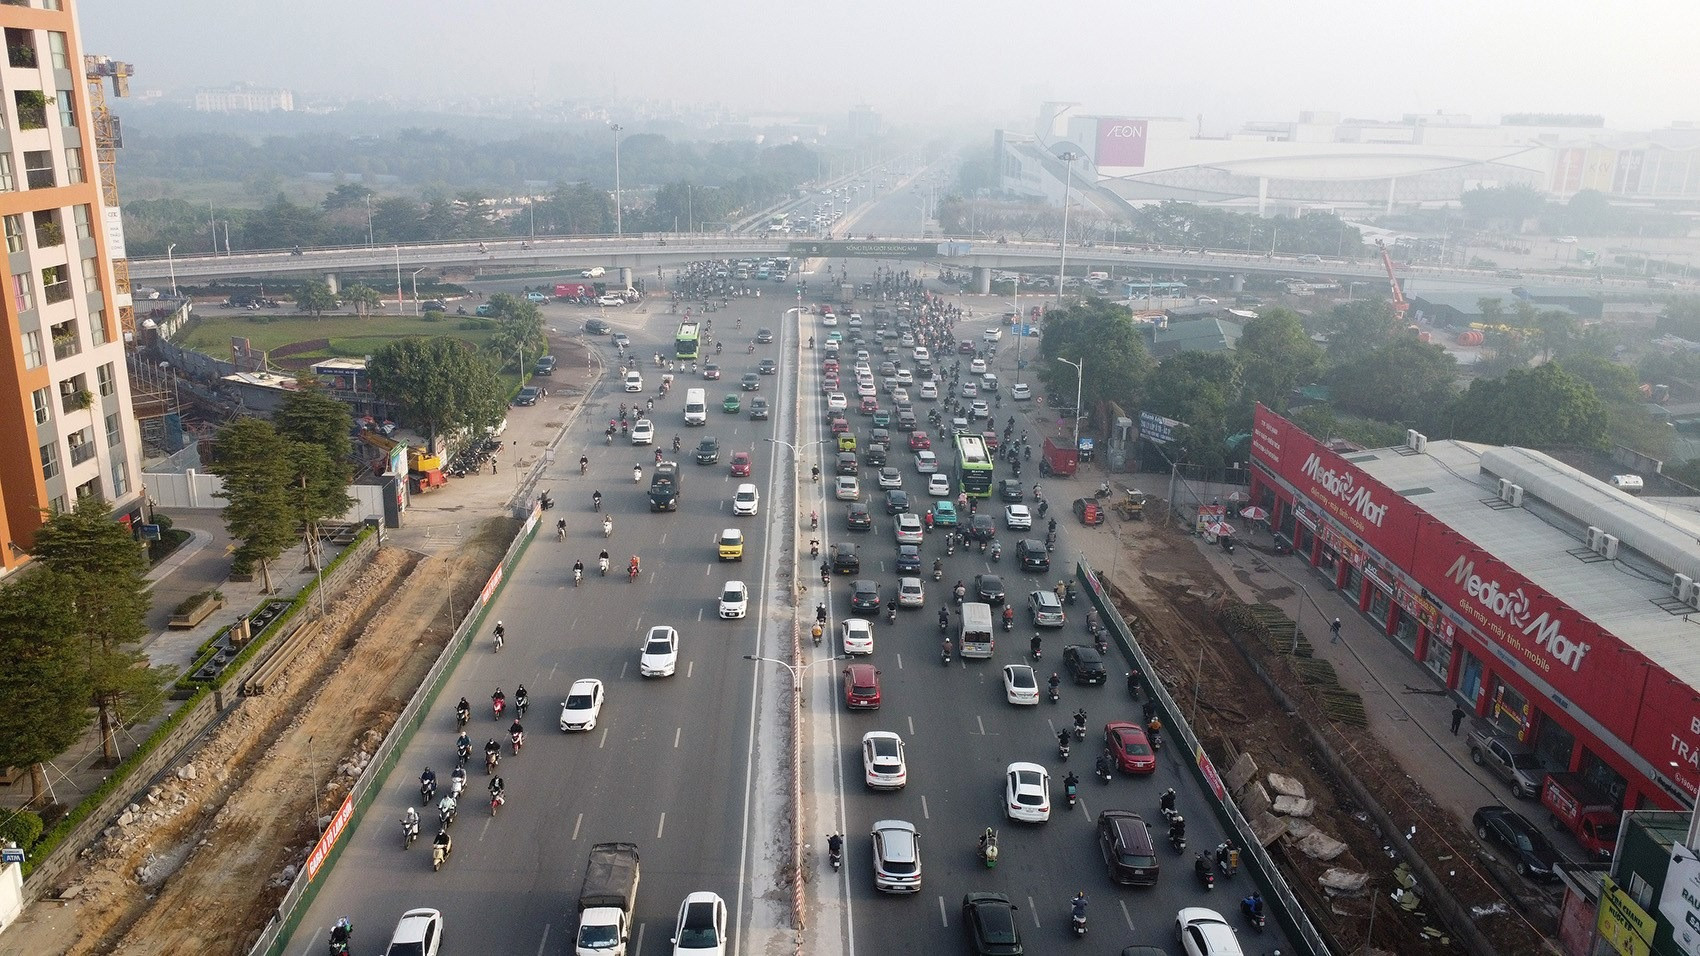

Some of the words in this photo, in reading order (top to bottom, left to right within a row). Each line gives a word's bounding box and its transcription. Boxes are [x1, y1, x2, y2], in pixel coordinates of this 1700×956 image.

[1348, 486, 1387, 528] Mart
[1445, 554, 1509, 618] Media
[1522, 611, 1587, 672] Mart
[1460, 599, 1473, 614] điện
[1473, 609, 1488, 626] máy
[1491, 622, 1506, 640] máy
[1506, 633, 1521, 651] tính
[1524, 648, 1550, 673] mobile
